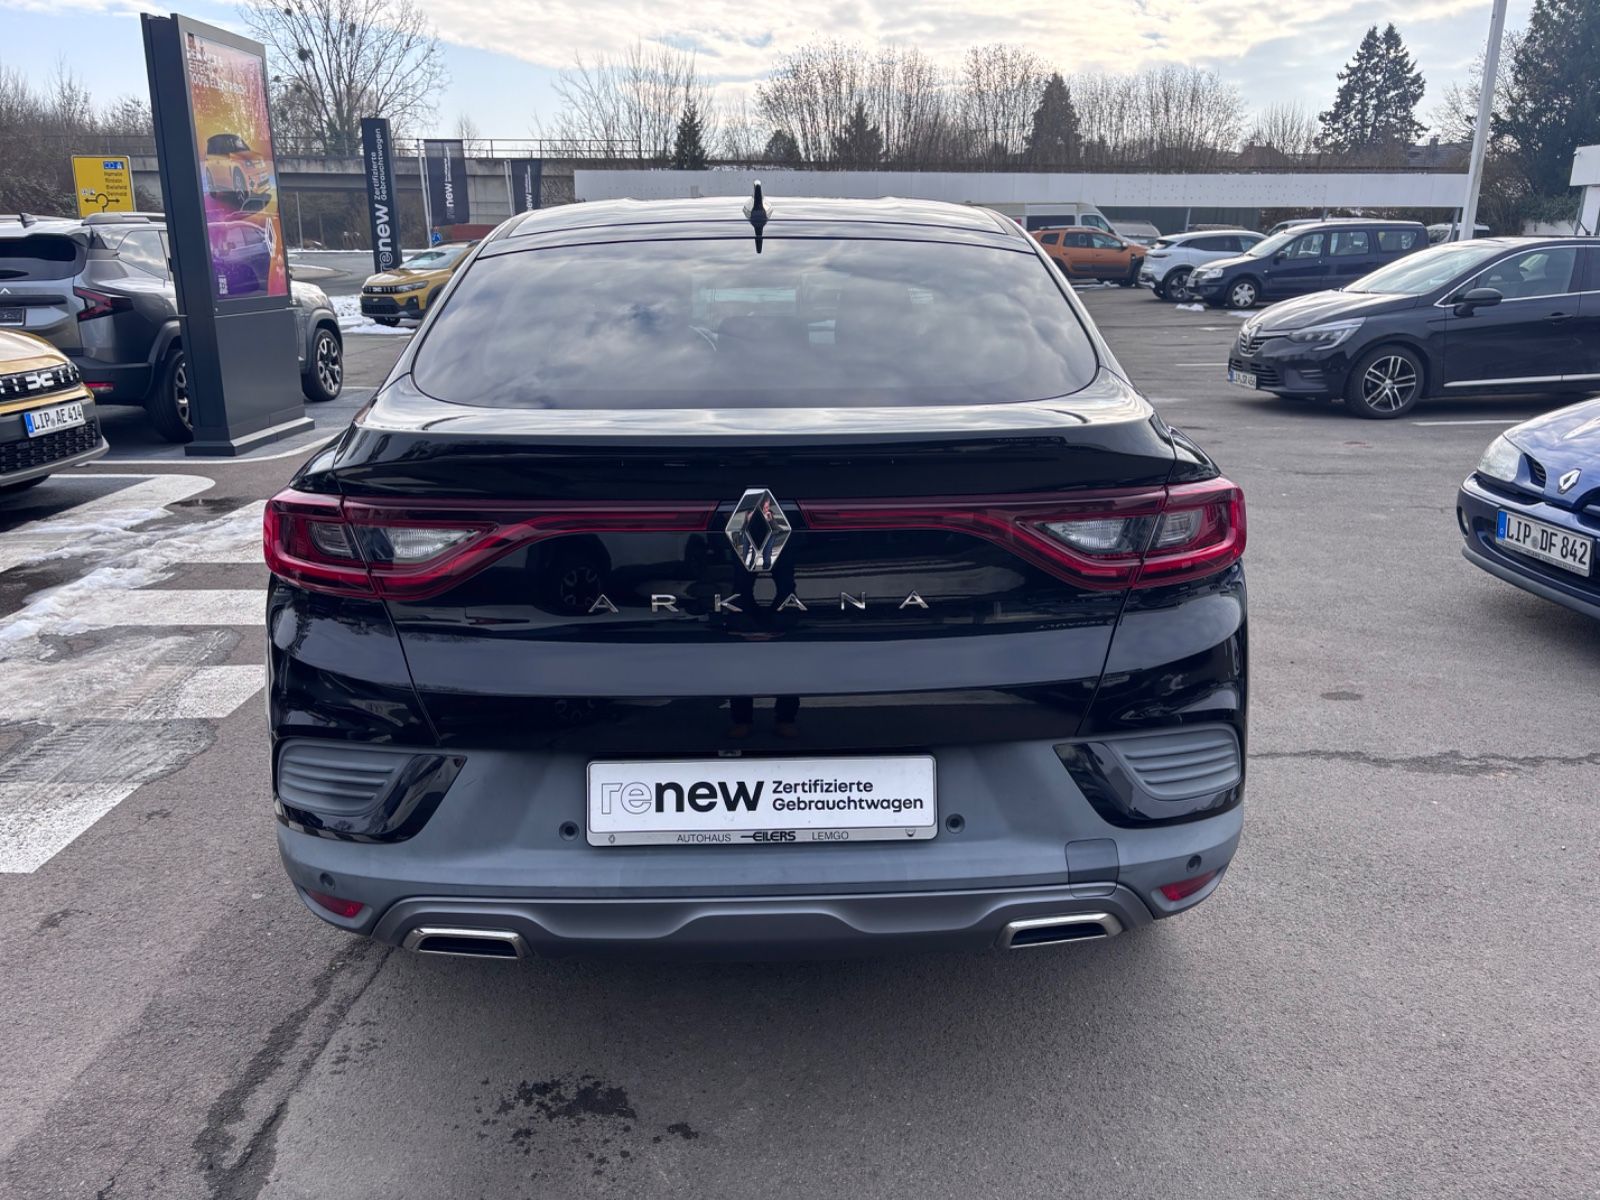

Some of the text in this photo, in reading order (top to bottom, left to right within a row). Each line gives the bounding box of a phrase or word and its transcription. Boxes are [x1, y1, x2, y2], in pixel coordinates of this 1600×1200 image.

[374, 203, 393, 273] renew
[32, 412, 50, 430] LIP
[56, 408, 67, 423] AE
[1506, 517, 1532, 545] LIP
[1539, 528, 1558, 554] DF
[1560, 536, 1588, 566] 842
[588, 590, 930, 613] ARKANA
[601, 780, 765, 815] renew
[772, 779, 874, 795] Zertifizierte
[772, 795, 924, 813] Gebrauchtwagen
[676, 830, 850, 843] AUTOHAUS EILERS LEMGO
